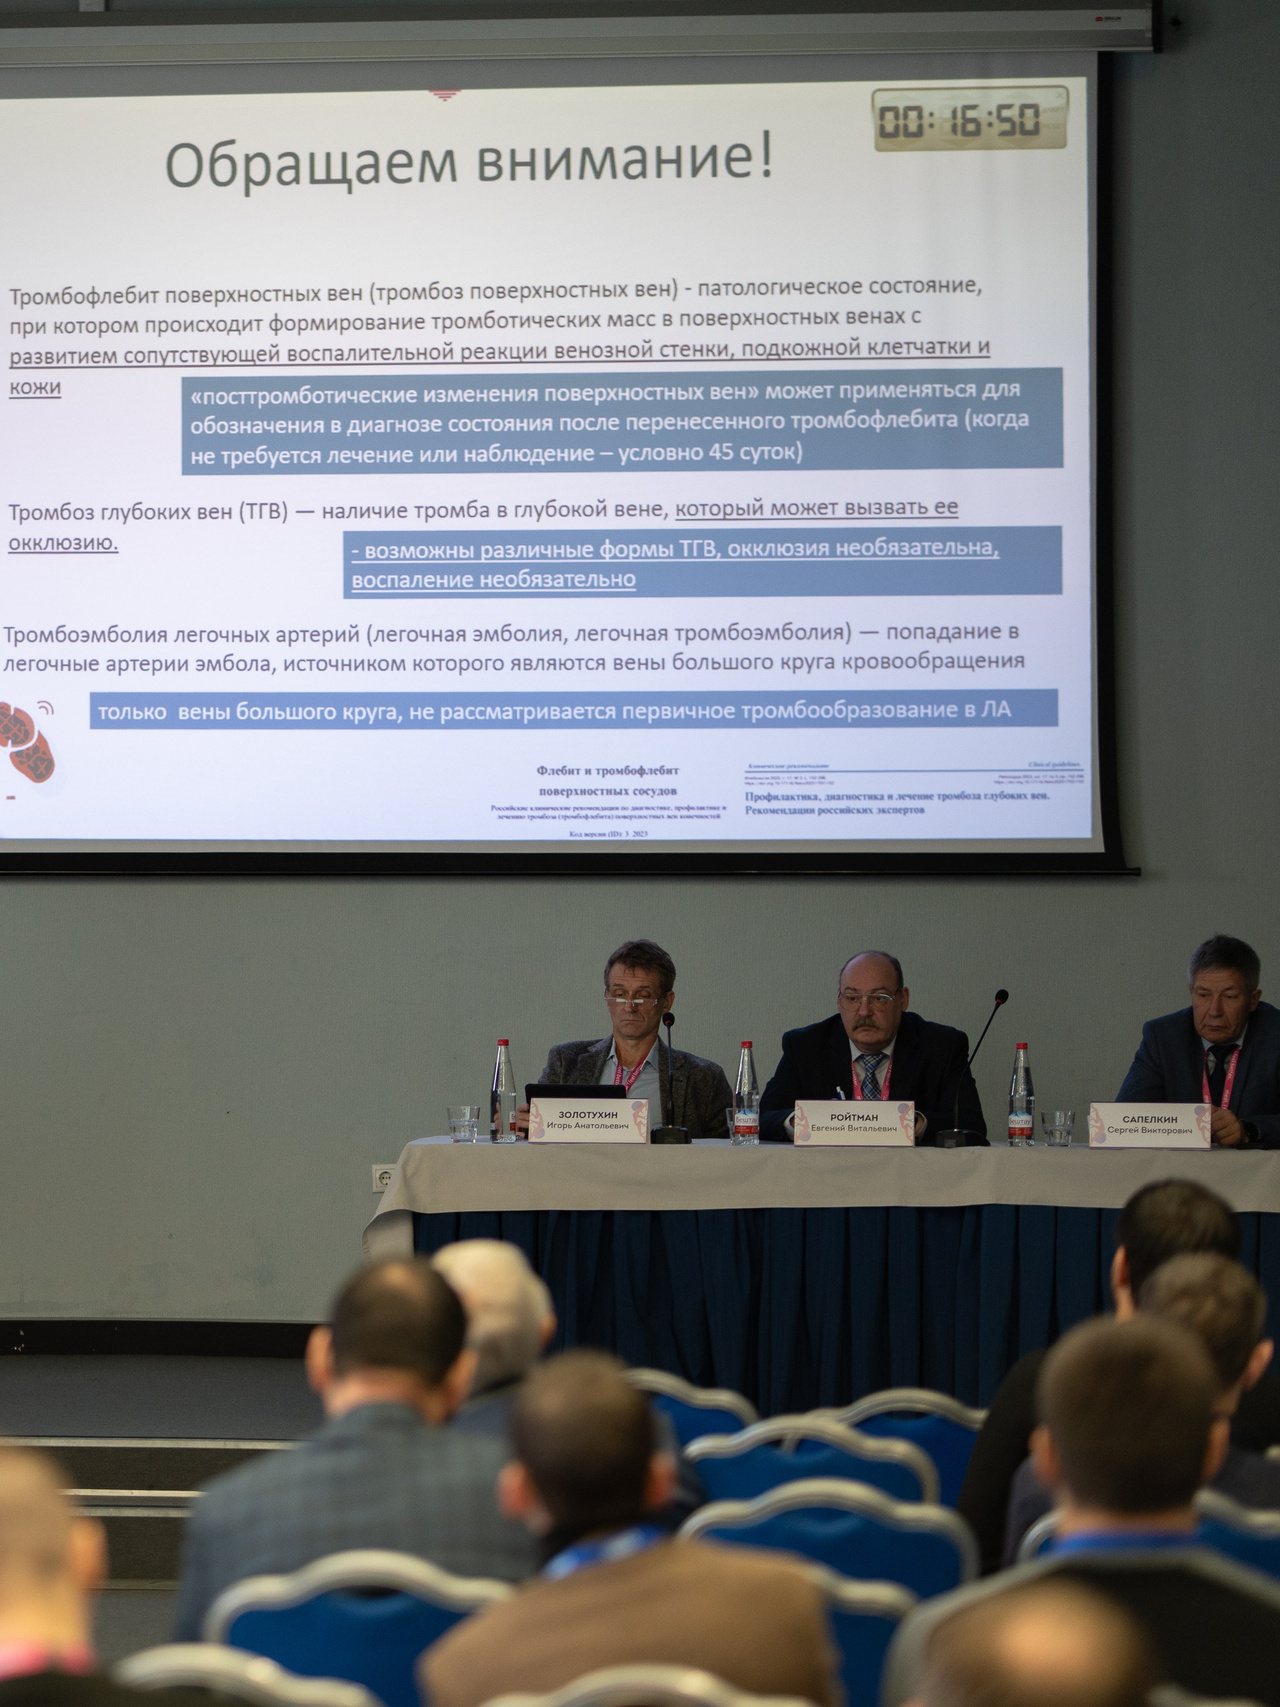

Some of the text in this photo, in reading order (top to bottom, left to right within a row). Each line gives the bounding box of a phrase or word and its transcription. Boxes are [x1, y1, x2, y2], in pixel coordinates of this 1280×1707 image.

[878, 103, 1041, 138] 00:16:50
[166, 129, 772, 197] Обращаем внимание!
[9, 277, 982, 310] Тромбофлебит поверхностных вен (тромбоз поверхностных вен) патологическое состояние,
[10, 309, 922, 339] при котором происходит формирование тромботических масс в поверхностных венах с
[10, 335, 990, 367] развитием сопутствующей воспалительной реакции венозной стенки, подкожной клетчатки и
[10, 381, 61, 395] кожи
[191, 382, 1020, 408] «посттромботические изменения поверхностных вен» может применяться для
[190, 407, 1029, 436] обозначения в диагнозе состояния после перенесенного тромбофлебита (когда
[191, 439, 803, 468] не требуется лечение или наблюдение условно 45 суток)
[8, 496, 959, 526] Тромбоз глубоких вен (ТГВ) наличие тромба в глубокой вене, который может вызвать ее
[9, 536, 118, 551] окклюзию.
[365, 535, 999, 561] возможны различные формы ТГВ, окклюзия необязательна,
[352, 567, 636, 588] воспаление необязательно
[3, 620, 1020, 646] Тромбоэмболия легочных артерий (легочная эмболия, легочная тромбоэмболия) попадание в
[3, 649, 1025, 676] легочные артерии эмбола, источником которого являются вены большого круга кровообращения
[98, 698, 1012, 724] только вены большого круга, не рассматривается первичное тромбообразование в ЛА
[536, 764, 680, 778] Флебит и тромбофлебит
[539, 787, 678, 799] поверхностных сосудов
[745, 791, 822, 803] Профилактика,
[824, 793, 885, 802] диагностика
[895, 793, 934, 801] лечение
[936, 789, 982, 802] тромбоза
[984, 789, 1028, 802] глубоких
[1030, 792, 1050, 800] вен.
[745, 804, 926, 816] Рекомендации российских экспертов
[546, 1122, 573, 1130] Игорь
[558, 1111, 618, 1119] ЗОЛОТУХИН
[830, 1112, 879, 1121] РОЙТМАН
[1122, 1115, 1178, 1123] САПЕЛКИН
[811, 1124, 846, 1132] Евгений
[1107, 1126, 1193, 1136] Сергей Викторович
